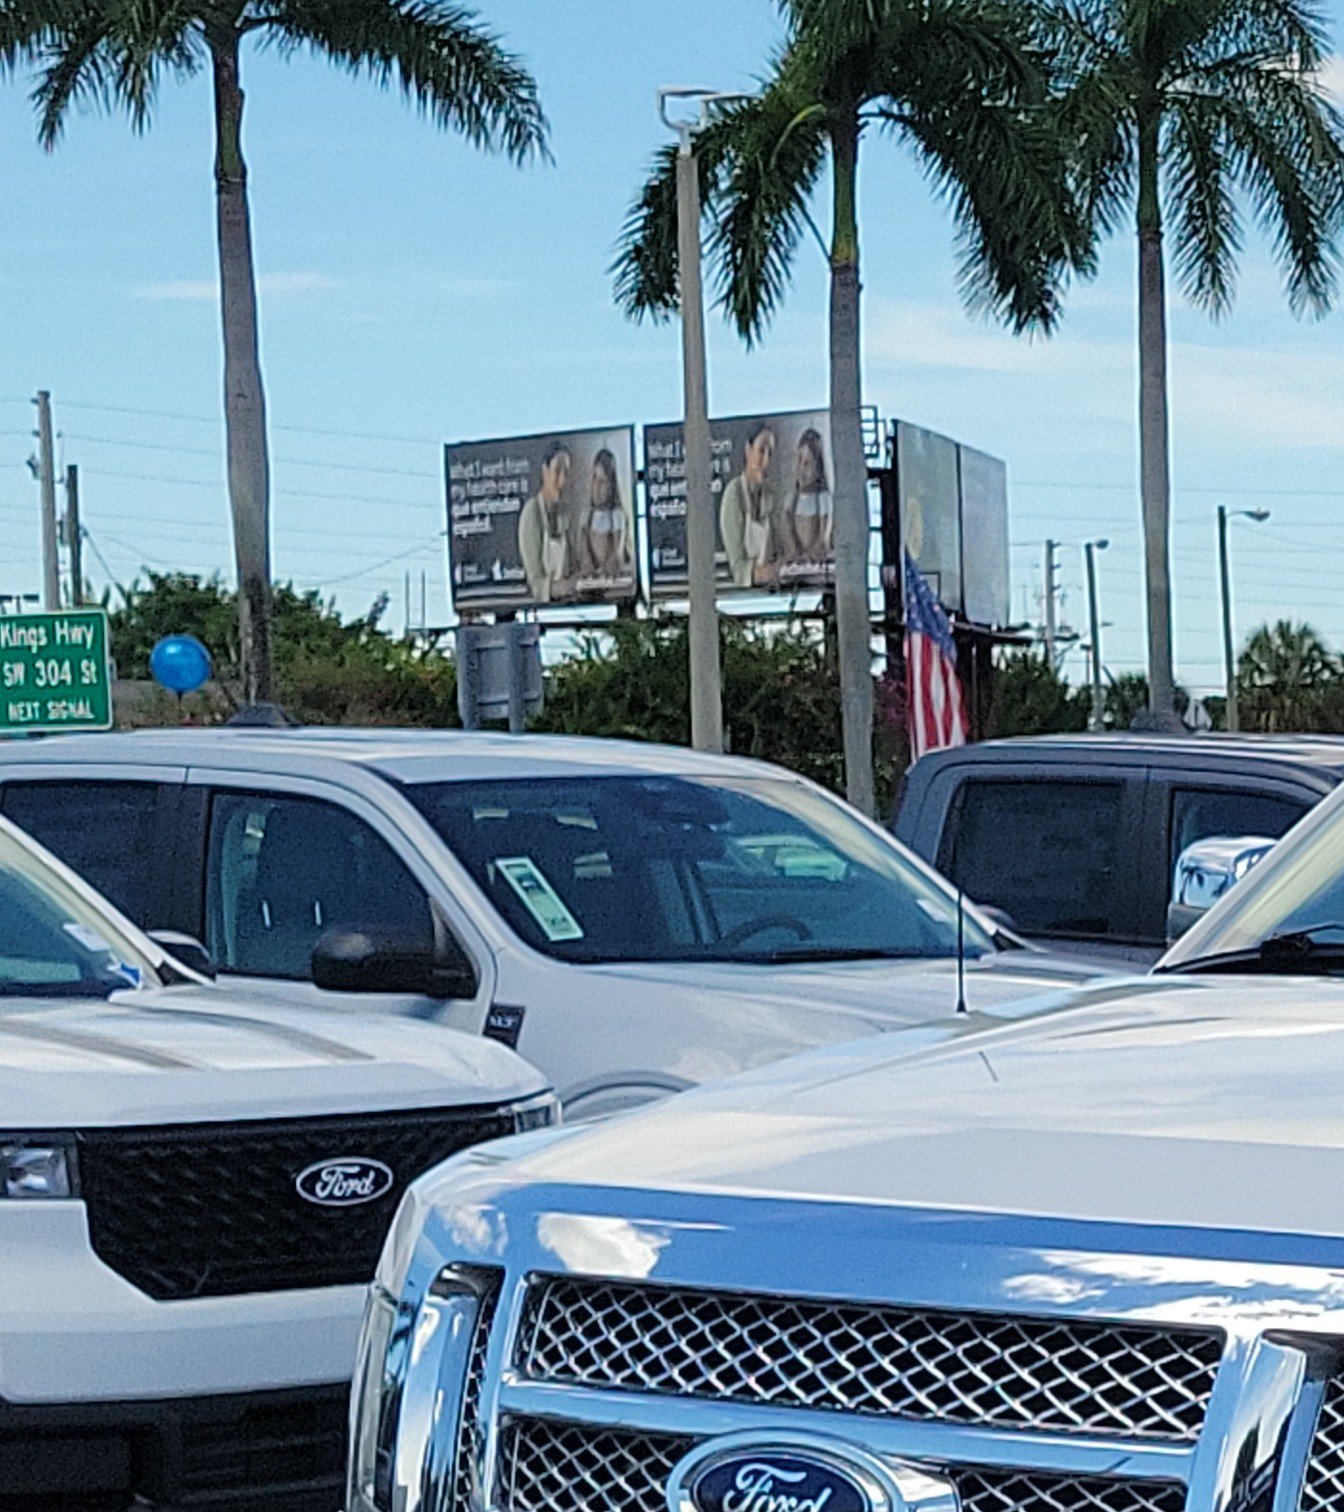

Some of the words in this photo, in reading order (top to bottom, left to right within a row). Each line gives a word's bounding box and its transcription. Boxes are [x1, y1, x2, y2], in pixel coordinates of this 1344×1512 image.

[0, 621, 48, 653] Kings
[55, 619, 94, 650] Hwy
[3, 661, 25, 687] SW
[35, 659, 72, 686] 304
[81, 658, 97, 684] St
[9, 702, 40, 721] NEXT
[47, 698, 95, 720] SIGNAL
[315, 1166, 376, 1198] Ford
